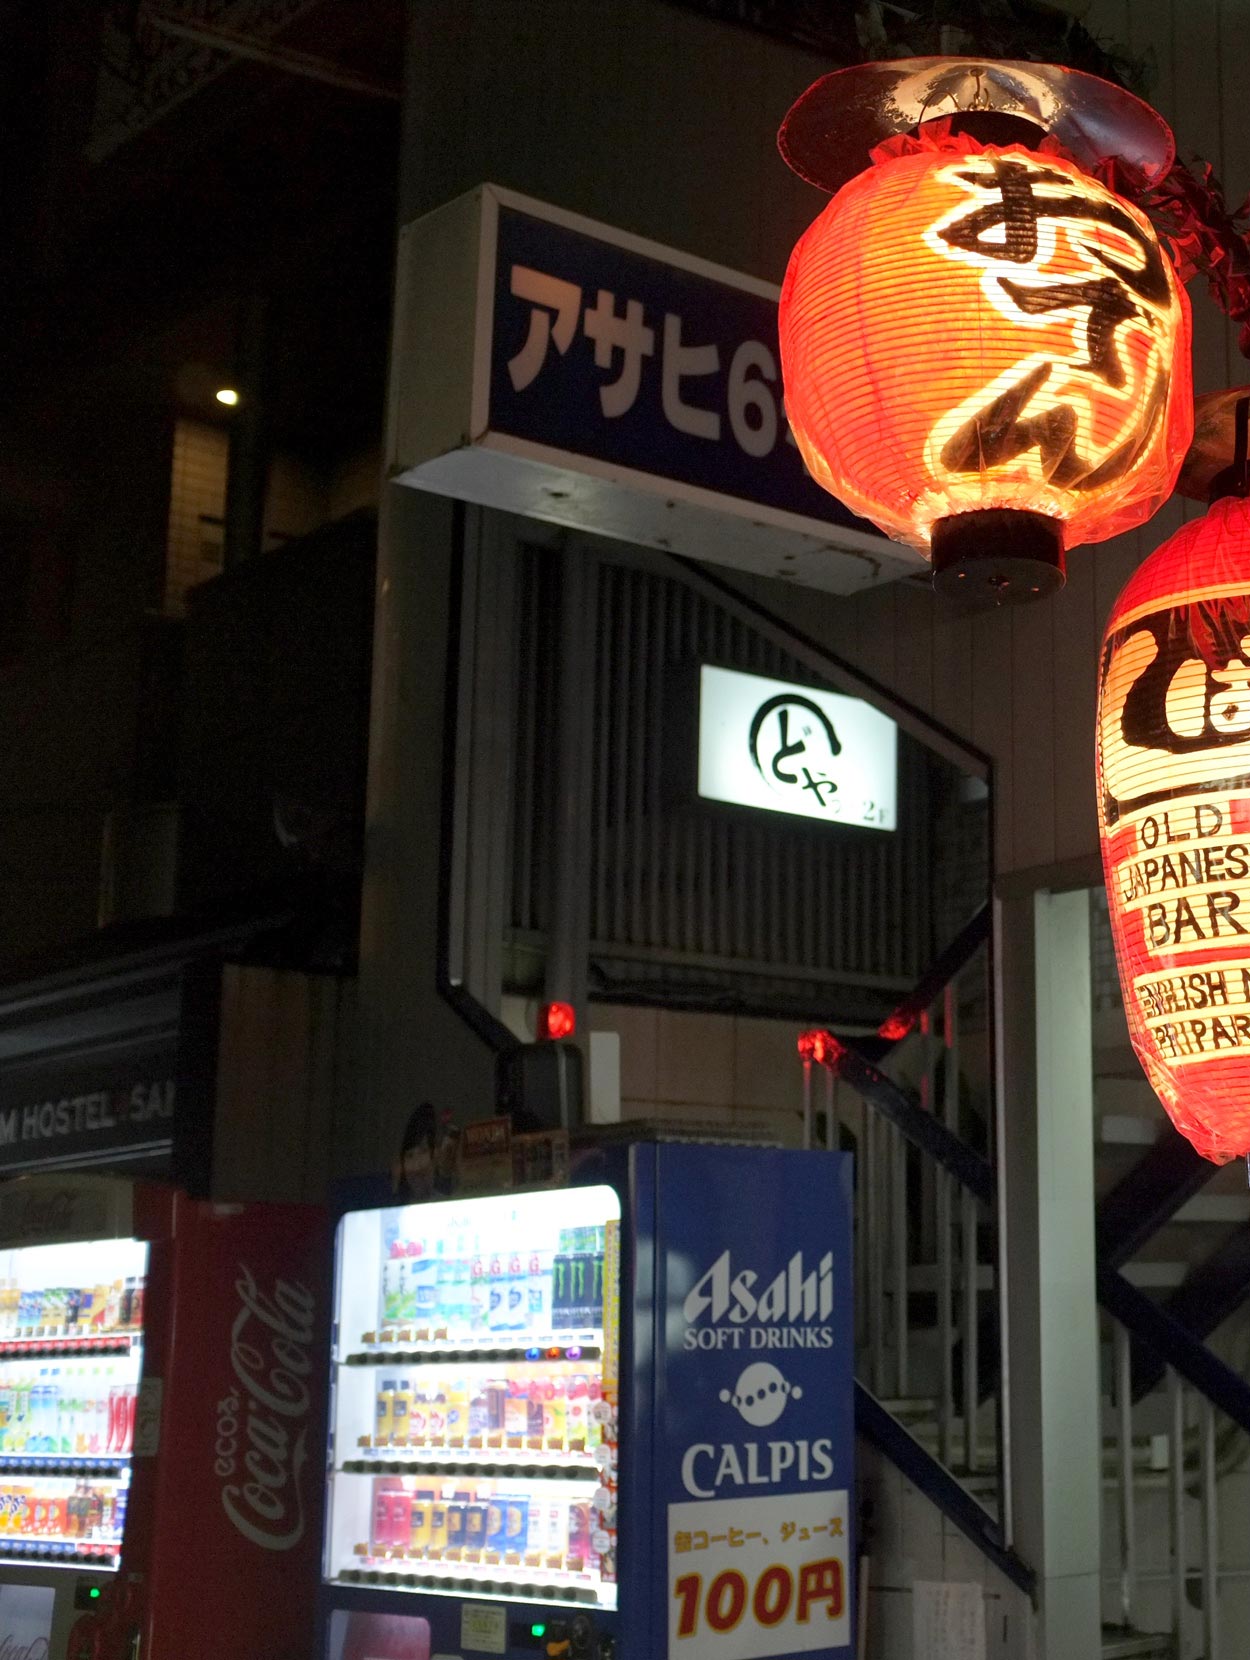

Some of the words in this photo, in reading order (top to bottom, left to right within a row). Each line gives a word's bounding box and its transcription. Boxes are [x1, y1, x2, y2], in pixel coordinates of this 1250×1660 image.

[936, 156, 1172, 494] おでん
[506, 262, 800, 460] アサヒ6
[1139, 802, 1223, 850] OLD
[1147, 889, 1249, 948] BAR
[22, 1090, 117, 1141] HOSTEL
[683, 1249, 834, 1324] Asahi
[683, 1327, 745, 1351] SOFT
[749, 1326, 834, 1350] DRINKS
[681, 1438, 834, 1498] CALPIS
[673, 1555, 845, 1640] 100円
